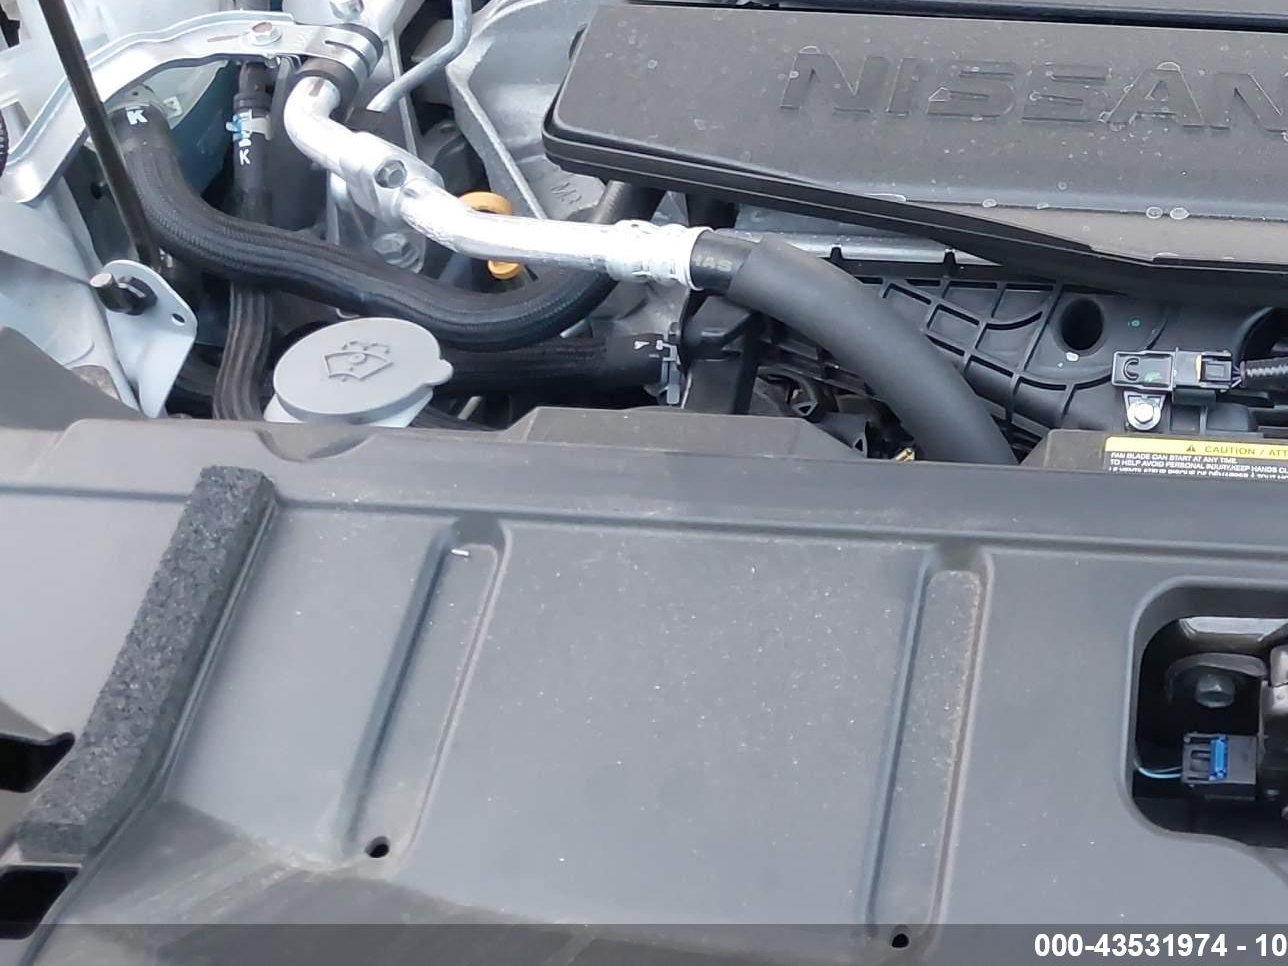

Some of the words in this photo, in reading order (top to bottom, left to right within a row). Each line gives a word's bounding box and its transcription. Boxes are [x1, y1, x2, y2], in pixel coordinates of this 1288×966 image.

[127, 108, 148, 125] K
[239, 149, 250, 165] K
[1204, 445, 1256, 455] CAUTION
[1169, 454, 1191, 462] START
[1121, 459, 1141, 467] HELP
[1165, 461, 1205, 470] PERSONAL
[1251, 465, 1277, 473] HANDS
